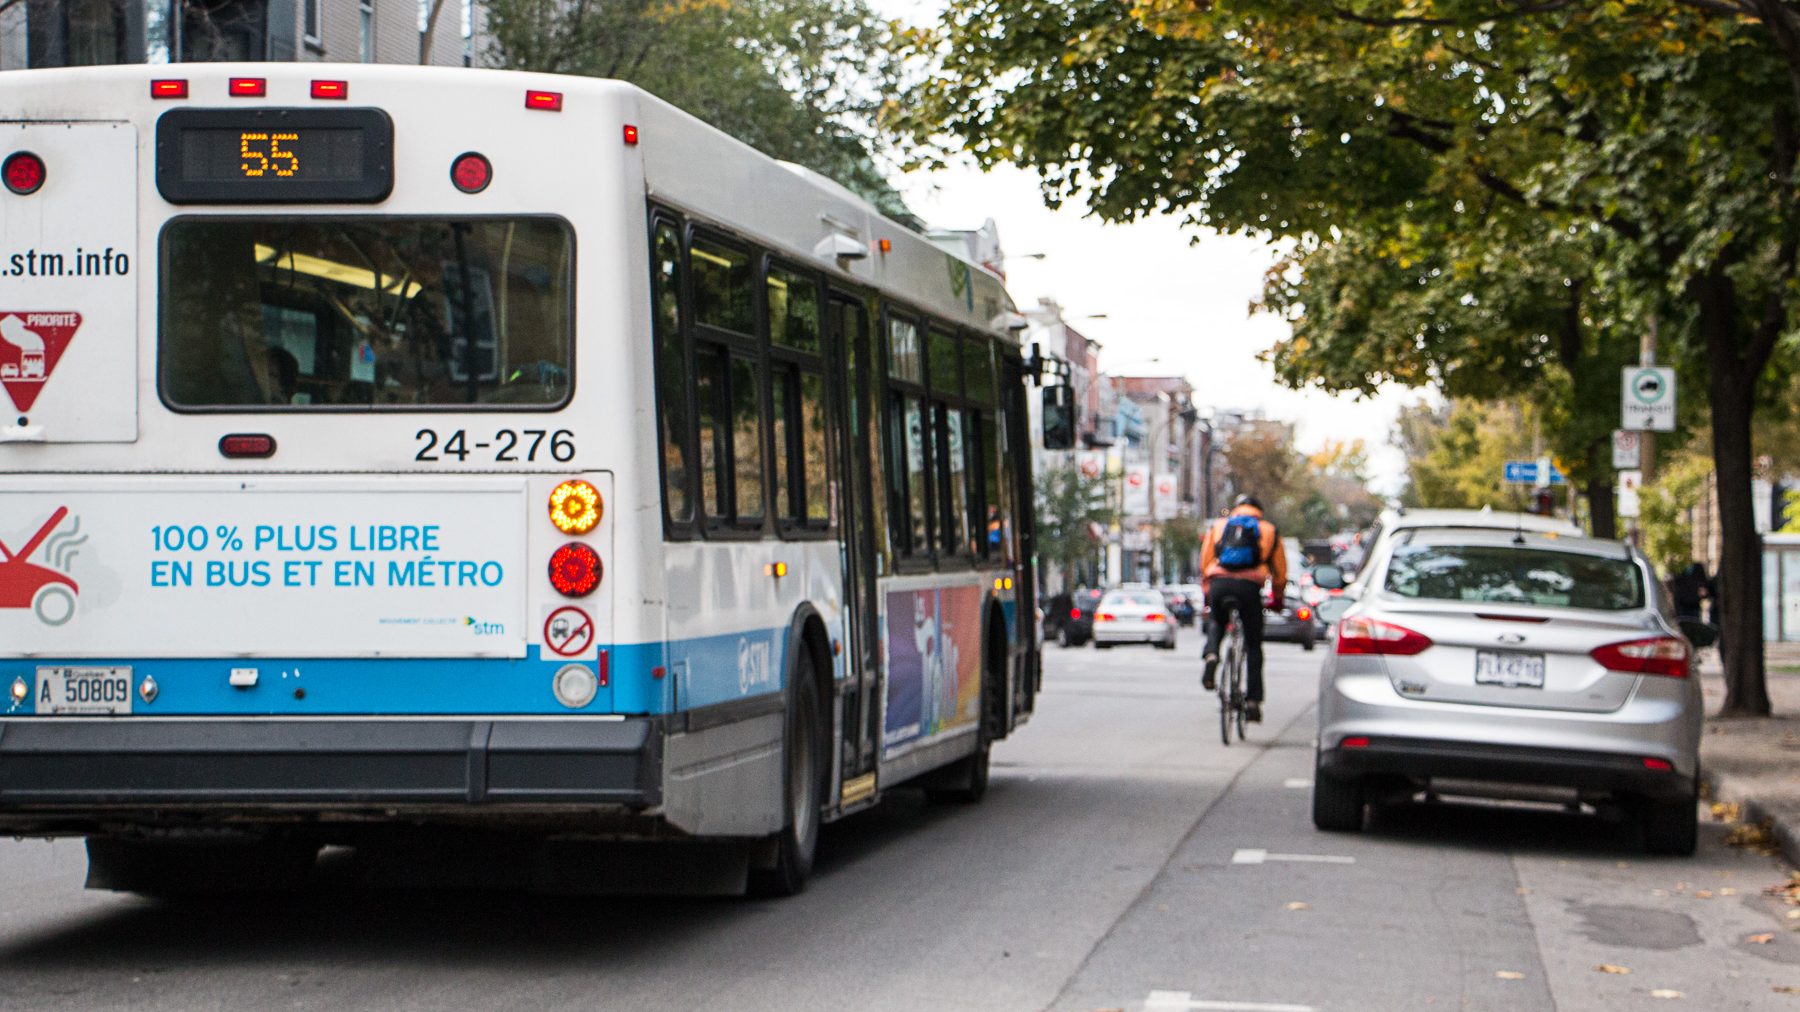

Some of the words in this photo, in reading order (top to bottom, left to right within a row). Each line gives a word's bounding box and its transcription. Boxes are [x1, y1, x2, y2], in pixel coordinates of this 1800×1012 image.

[241, 133, 299, 176] 55
[2, 247, 129, 276] .stm.info
[415, 428, 576, 462] 24-276
[150, 525, 209, 552] 100
[215, 525, 244, 552] %
[254, 525, 338, 552] PLUS
[349, 525, 441, 552] LIBRE
[150, 560, 193, 587] EN
[205, 560, 272, 587] BUS
[283, 560, 323, 587] ET
[334, 560, 375, 587] EN
[387, 555, 504, 588] MÉTRO
[474, 622, 504, 635] stm
[40, 680, 51, 703] A
[66, 679, 127, 702] 50809
